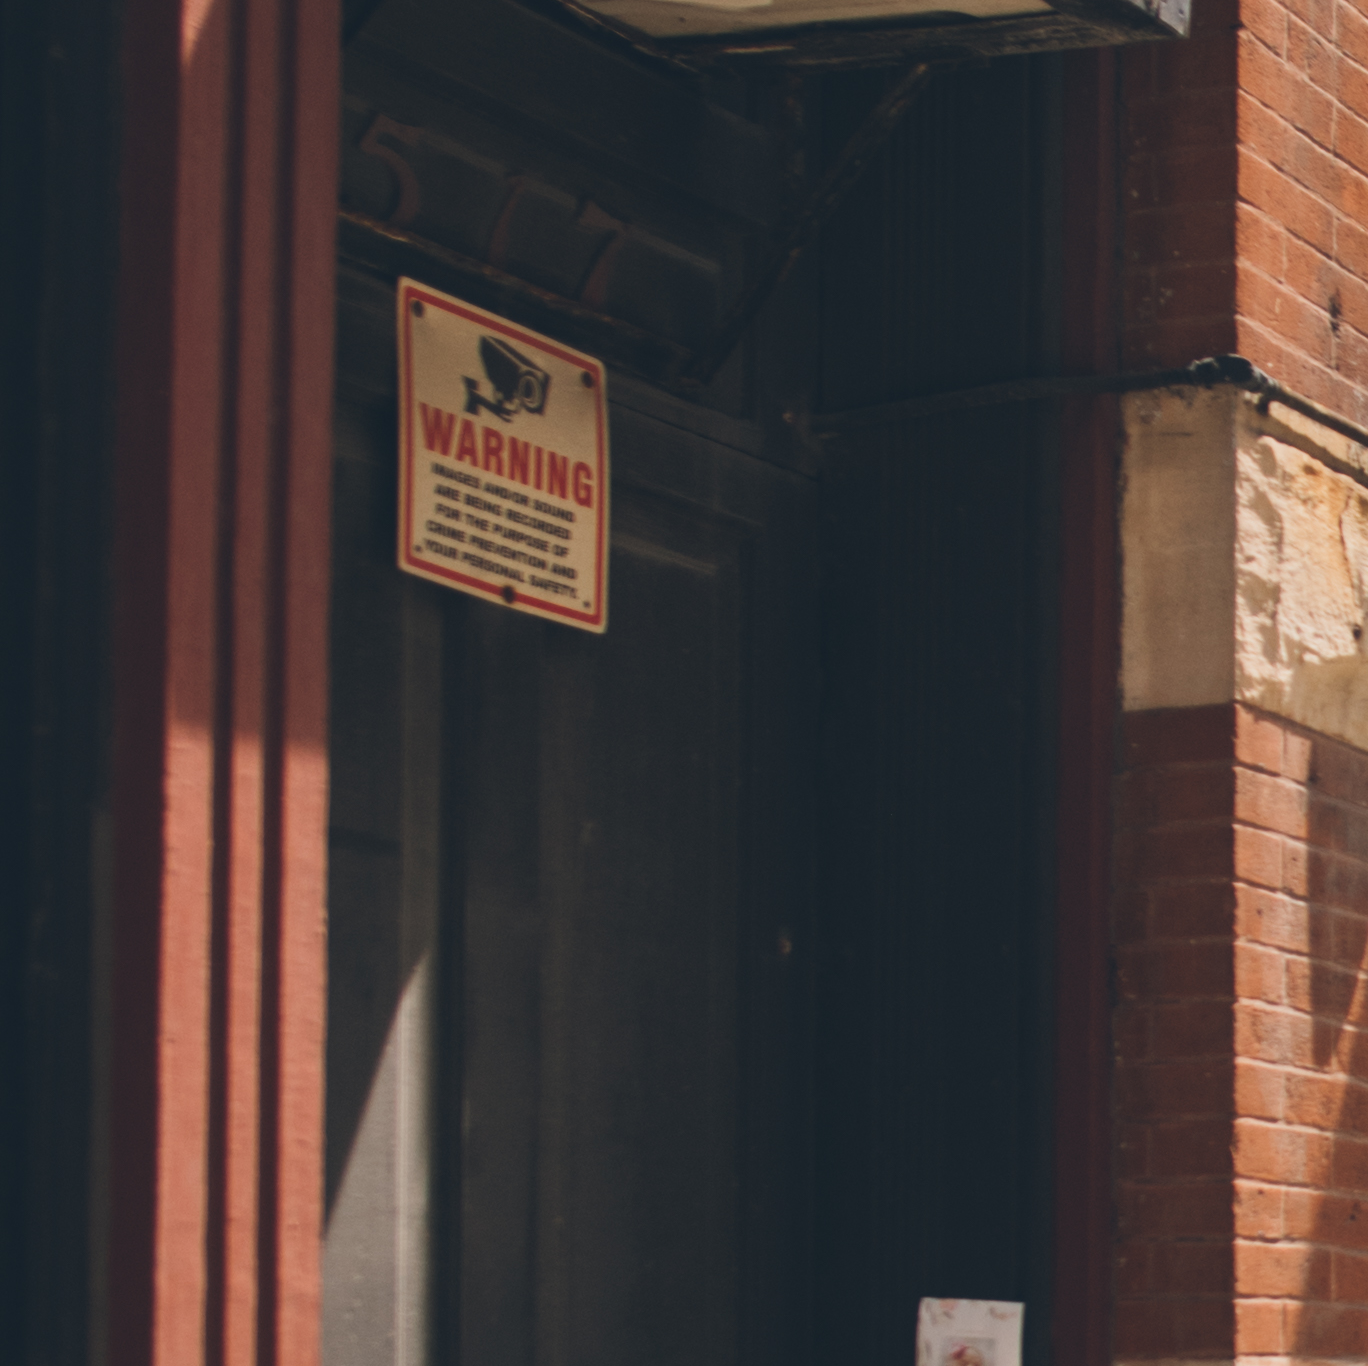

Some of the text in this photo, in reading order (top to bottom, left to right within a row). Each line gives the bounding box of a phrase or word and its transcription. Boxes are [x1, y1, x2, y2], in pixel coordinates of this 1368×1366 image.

[418, 401, 593, 509] WARNING
[431, 461, 481, 489] IMAGES
[531, 497, 576, 523] SOUND
[434, 483, 572, 540] ARE BEING RECORDED
[426, 519, 577, 580] CRIME PREVENTION AND
[434, 503, 569, 558] FOR THE PURPOSE OF
[424, 538, 458, 560] YOUR
[461, 550, 525, 583] PERSONAL
